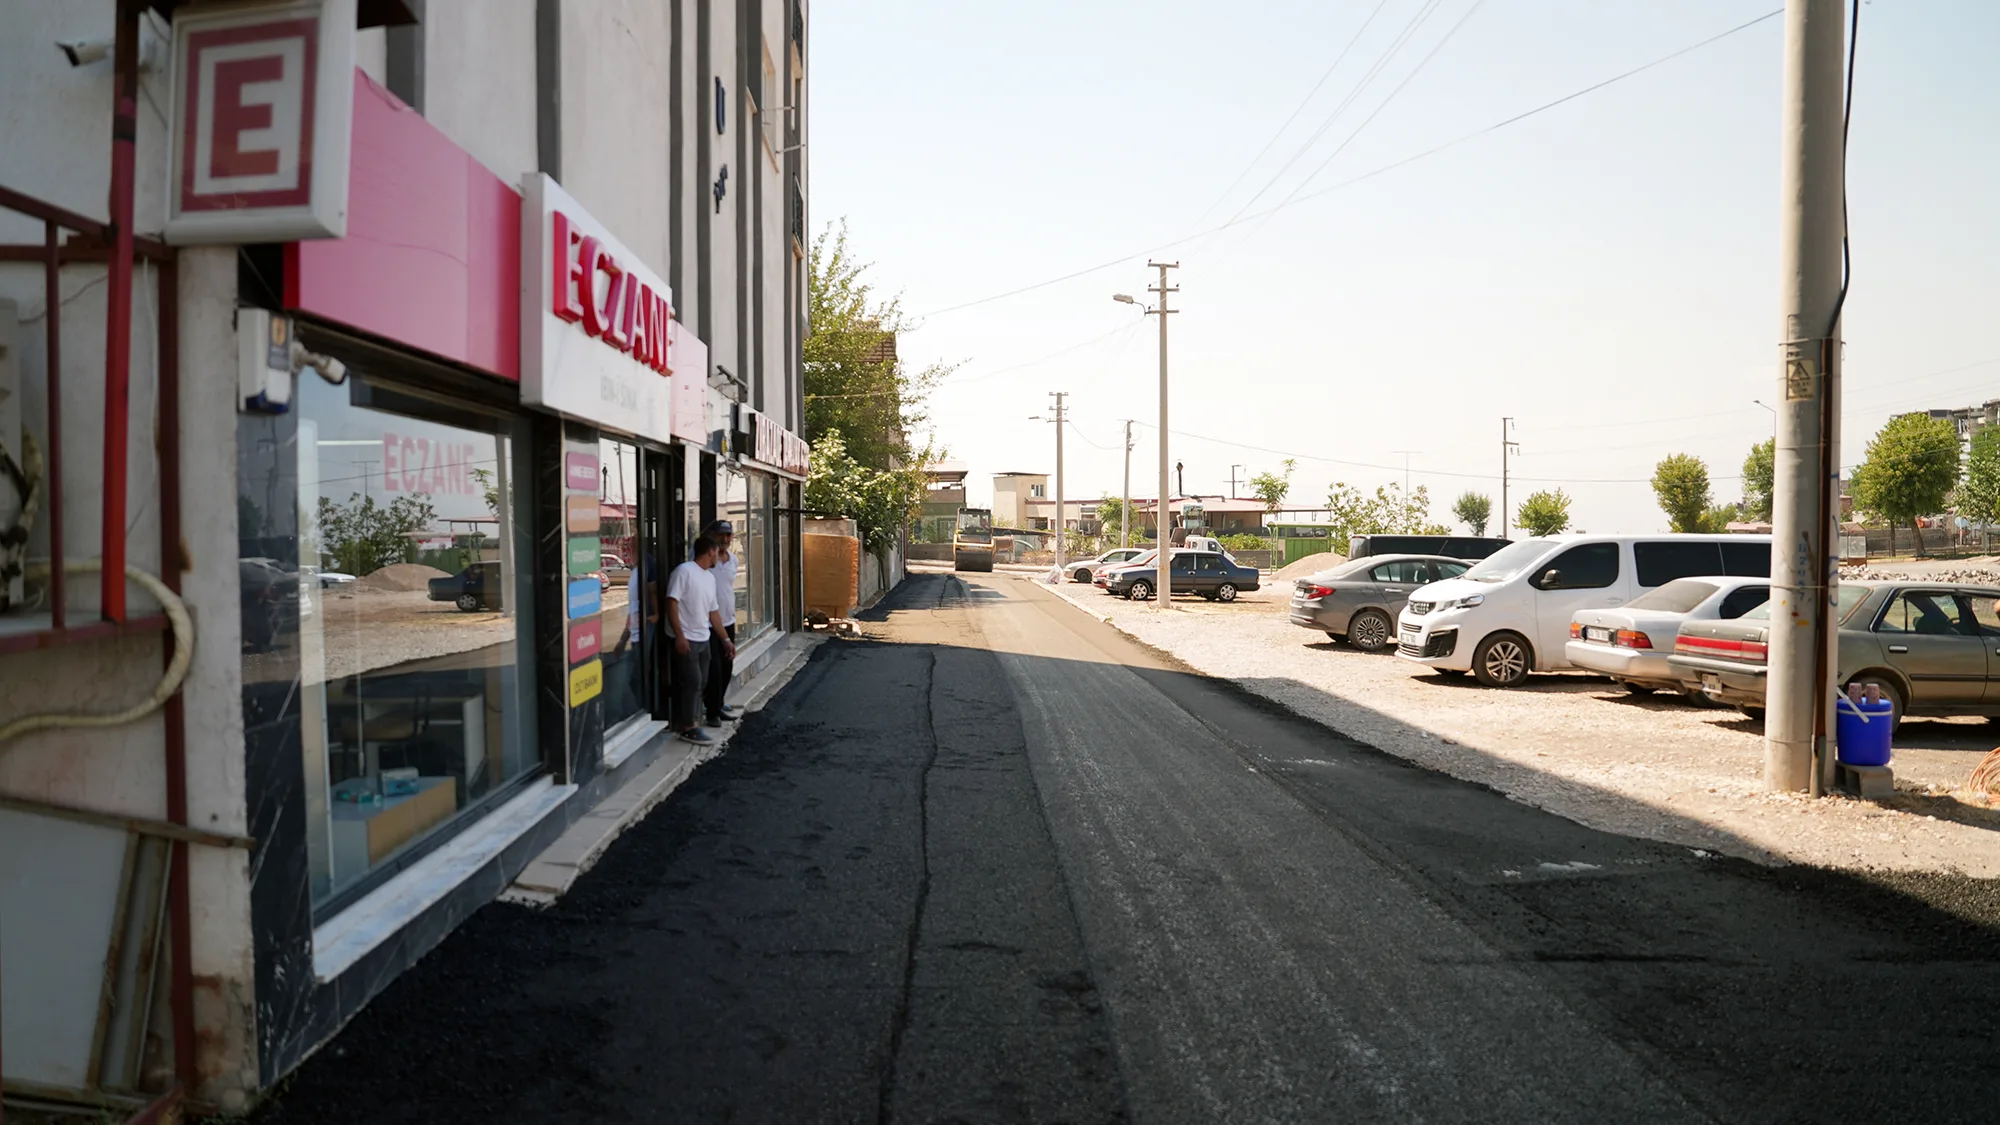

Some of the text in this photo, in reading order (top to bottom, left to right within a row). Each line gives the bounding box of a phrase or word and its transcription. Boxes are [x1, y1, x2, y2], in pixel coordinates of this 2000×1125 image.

[209, 55, 284, 179] E
[553, 210, 675, 377] ECZANE
[383, 432, 475, 495] ECZANE
